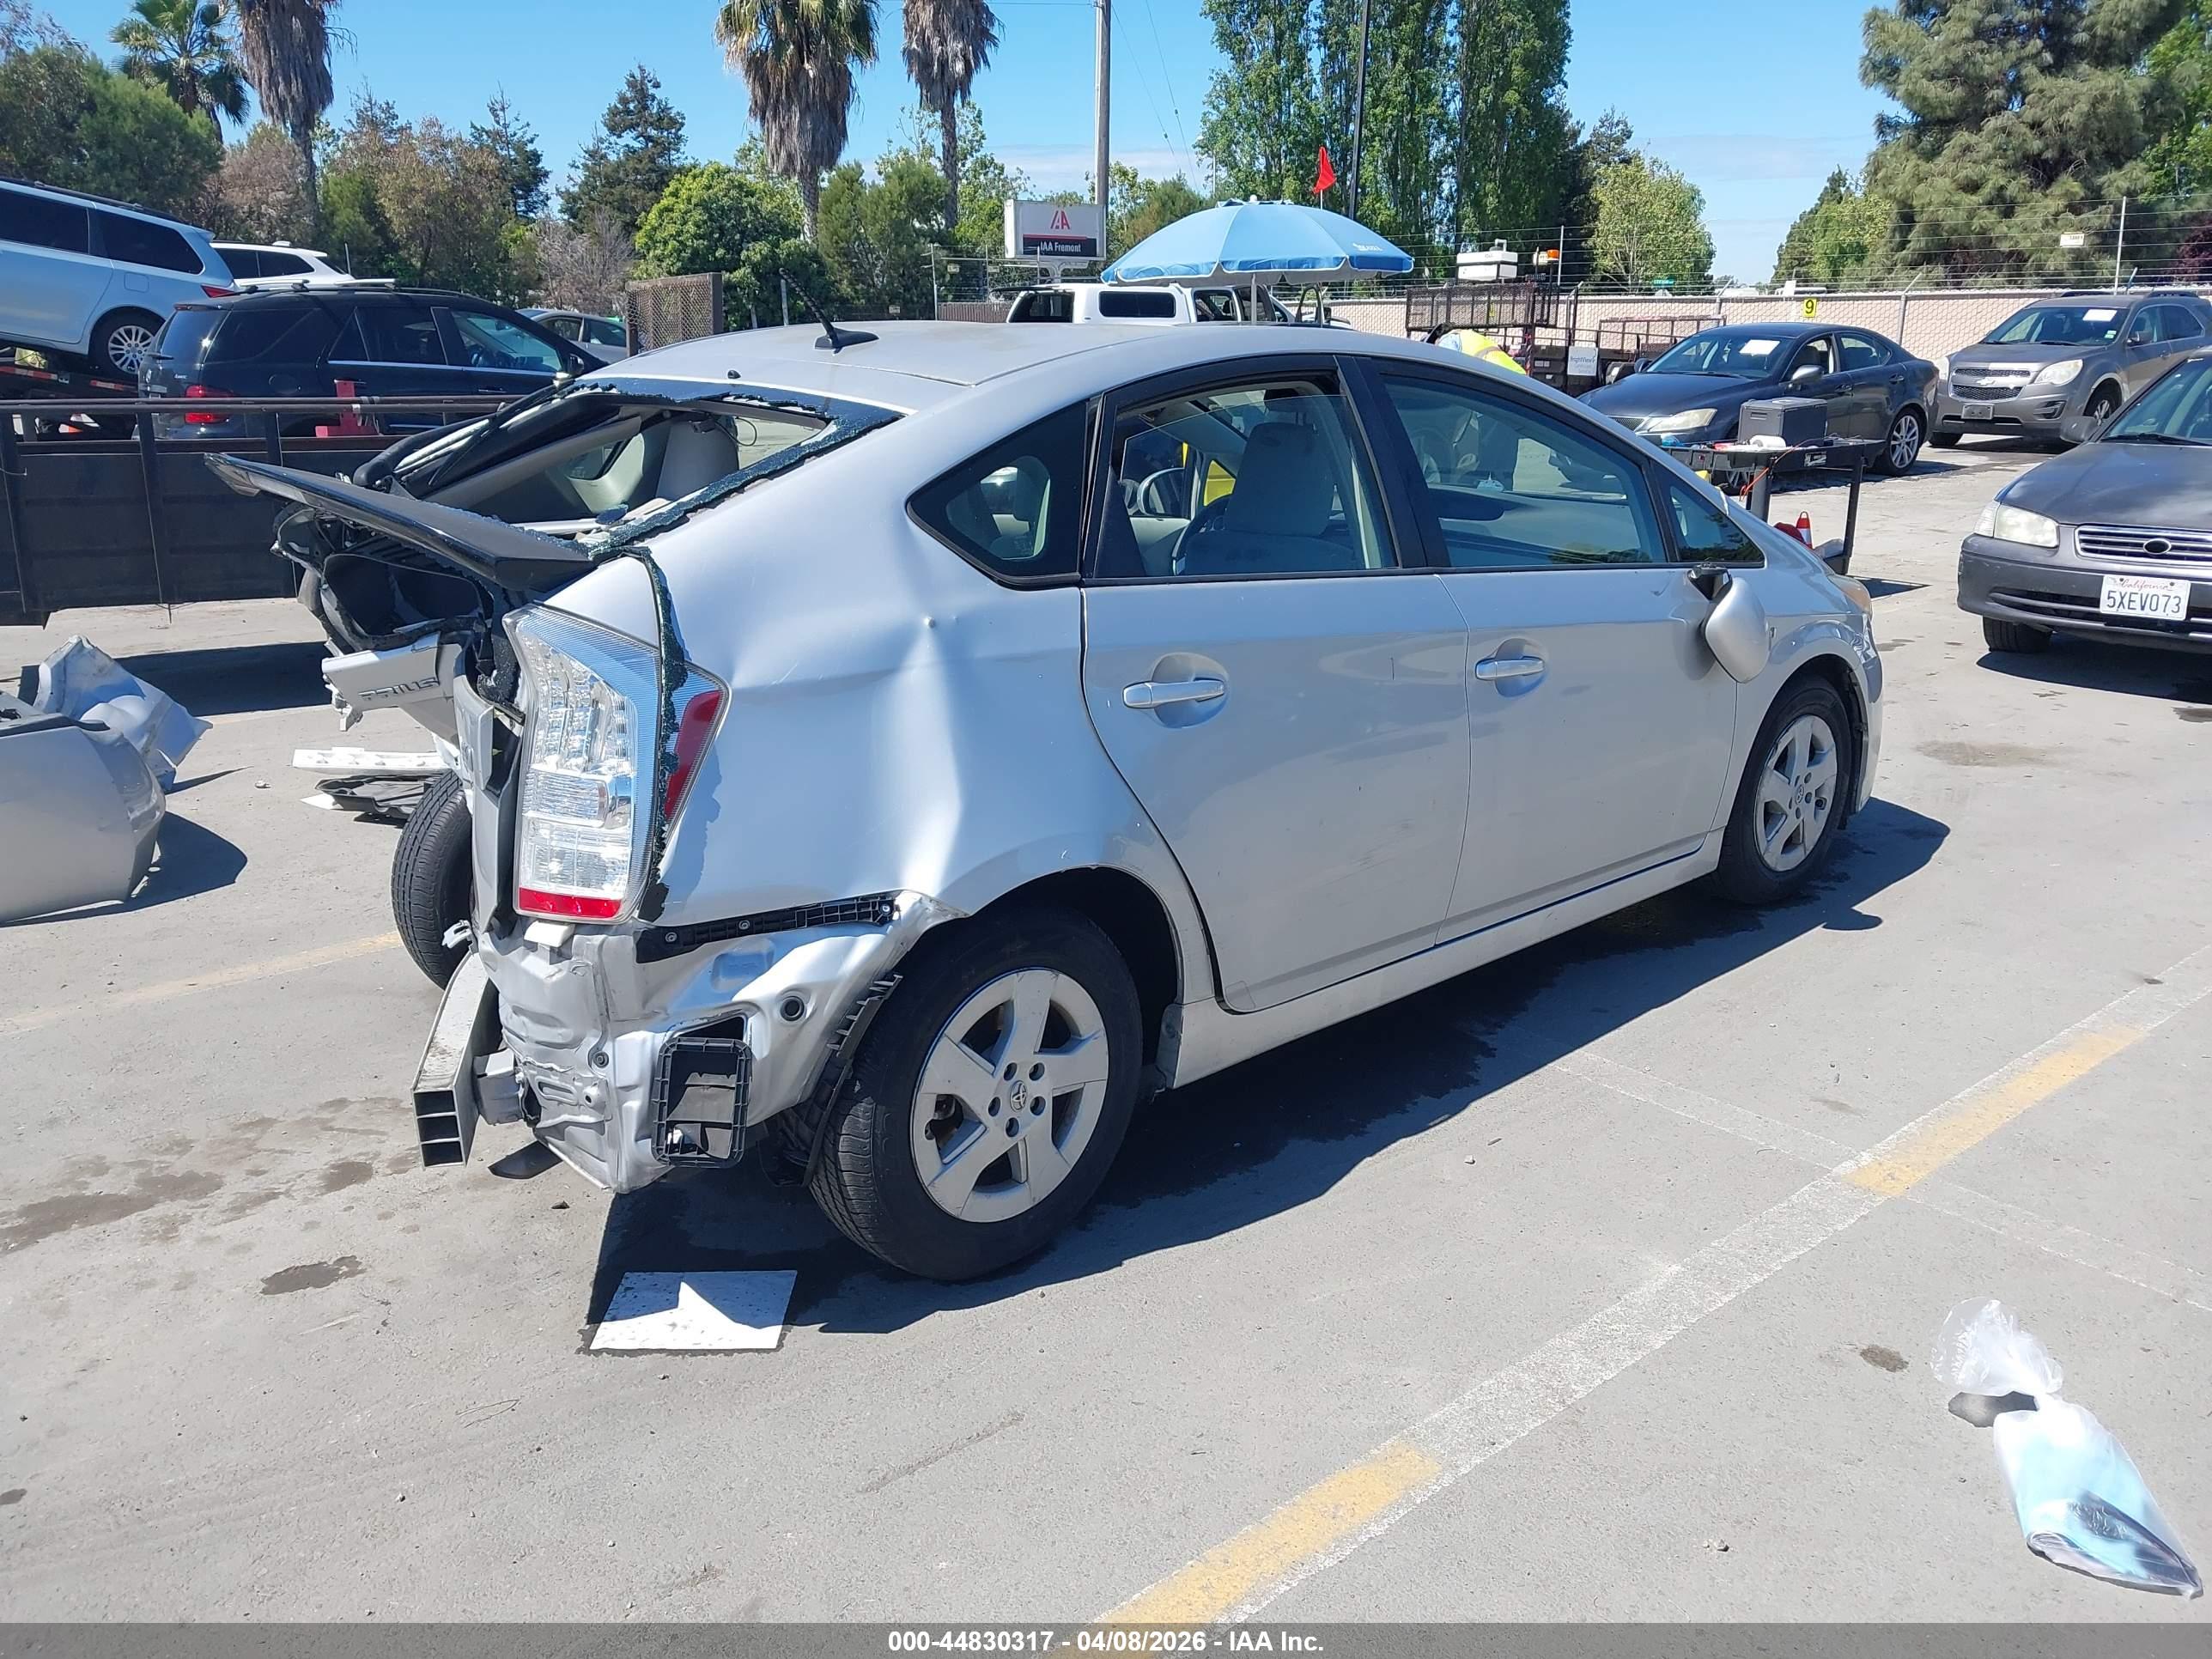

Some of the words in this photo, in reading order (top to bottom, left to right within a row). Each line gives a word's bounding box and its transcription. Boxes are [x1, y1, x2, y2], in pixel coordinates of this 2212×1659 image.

[1041, 241, 1054, 252] IAA
[1054, 242, 1081, 252] Fremont
[1805, 299, 1814, 314] 9
[2121, 579, 2172, 592] California
[2106, 591, 2181, 613] 5XEV073
[358, 677, 440, 700] PRIUS
